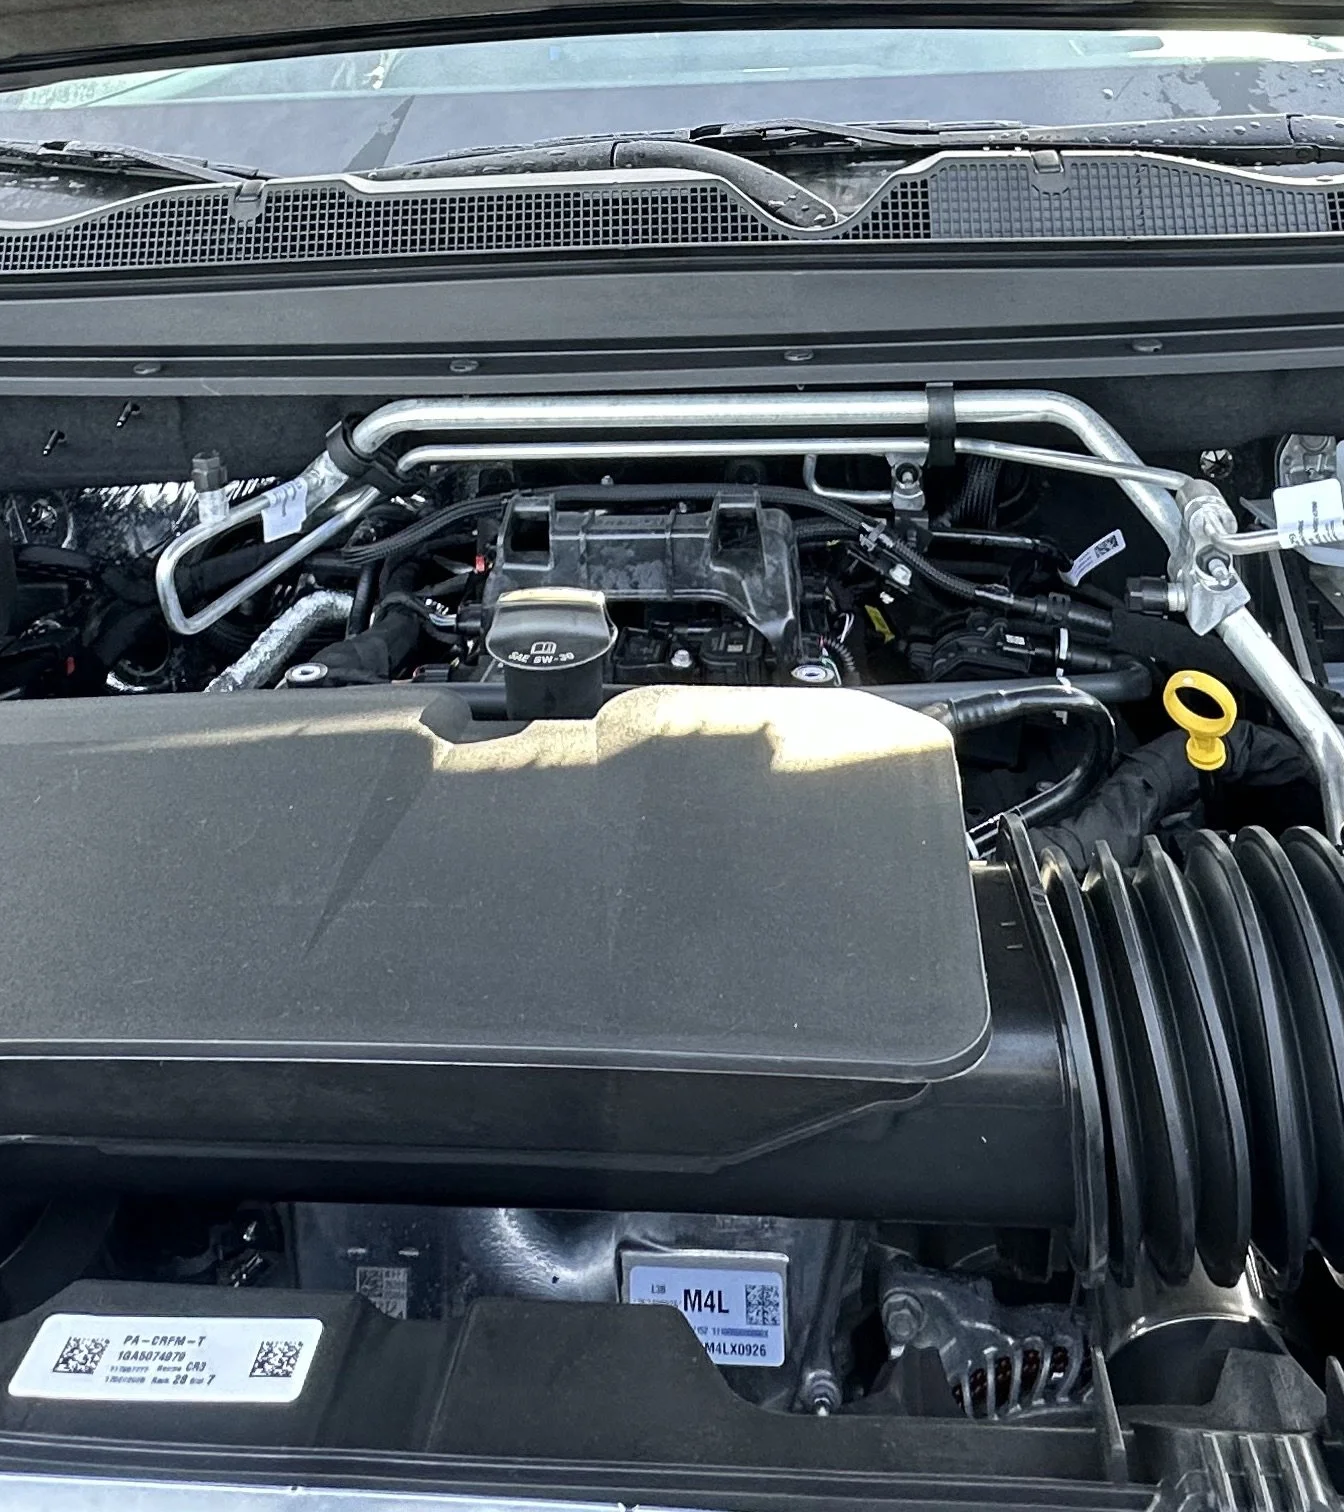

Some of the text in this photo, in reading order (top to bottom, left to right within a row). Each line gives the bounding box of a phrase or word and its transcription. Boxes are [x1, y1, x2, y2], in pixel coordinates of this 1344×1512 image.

[508, 651, 530, 663] SAE
[683, 1289, 729, 1314] M4L
[705, 1342, 767, 1357] M4LX0926
[206, 1374, 216, 1386] 7
